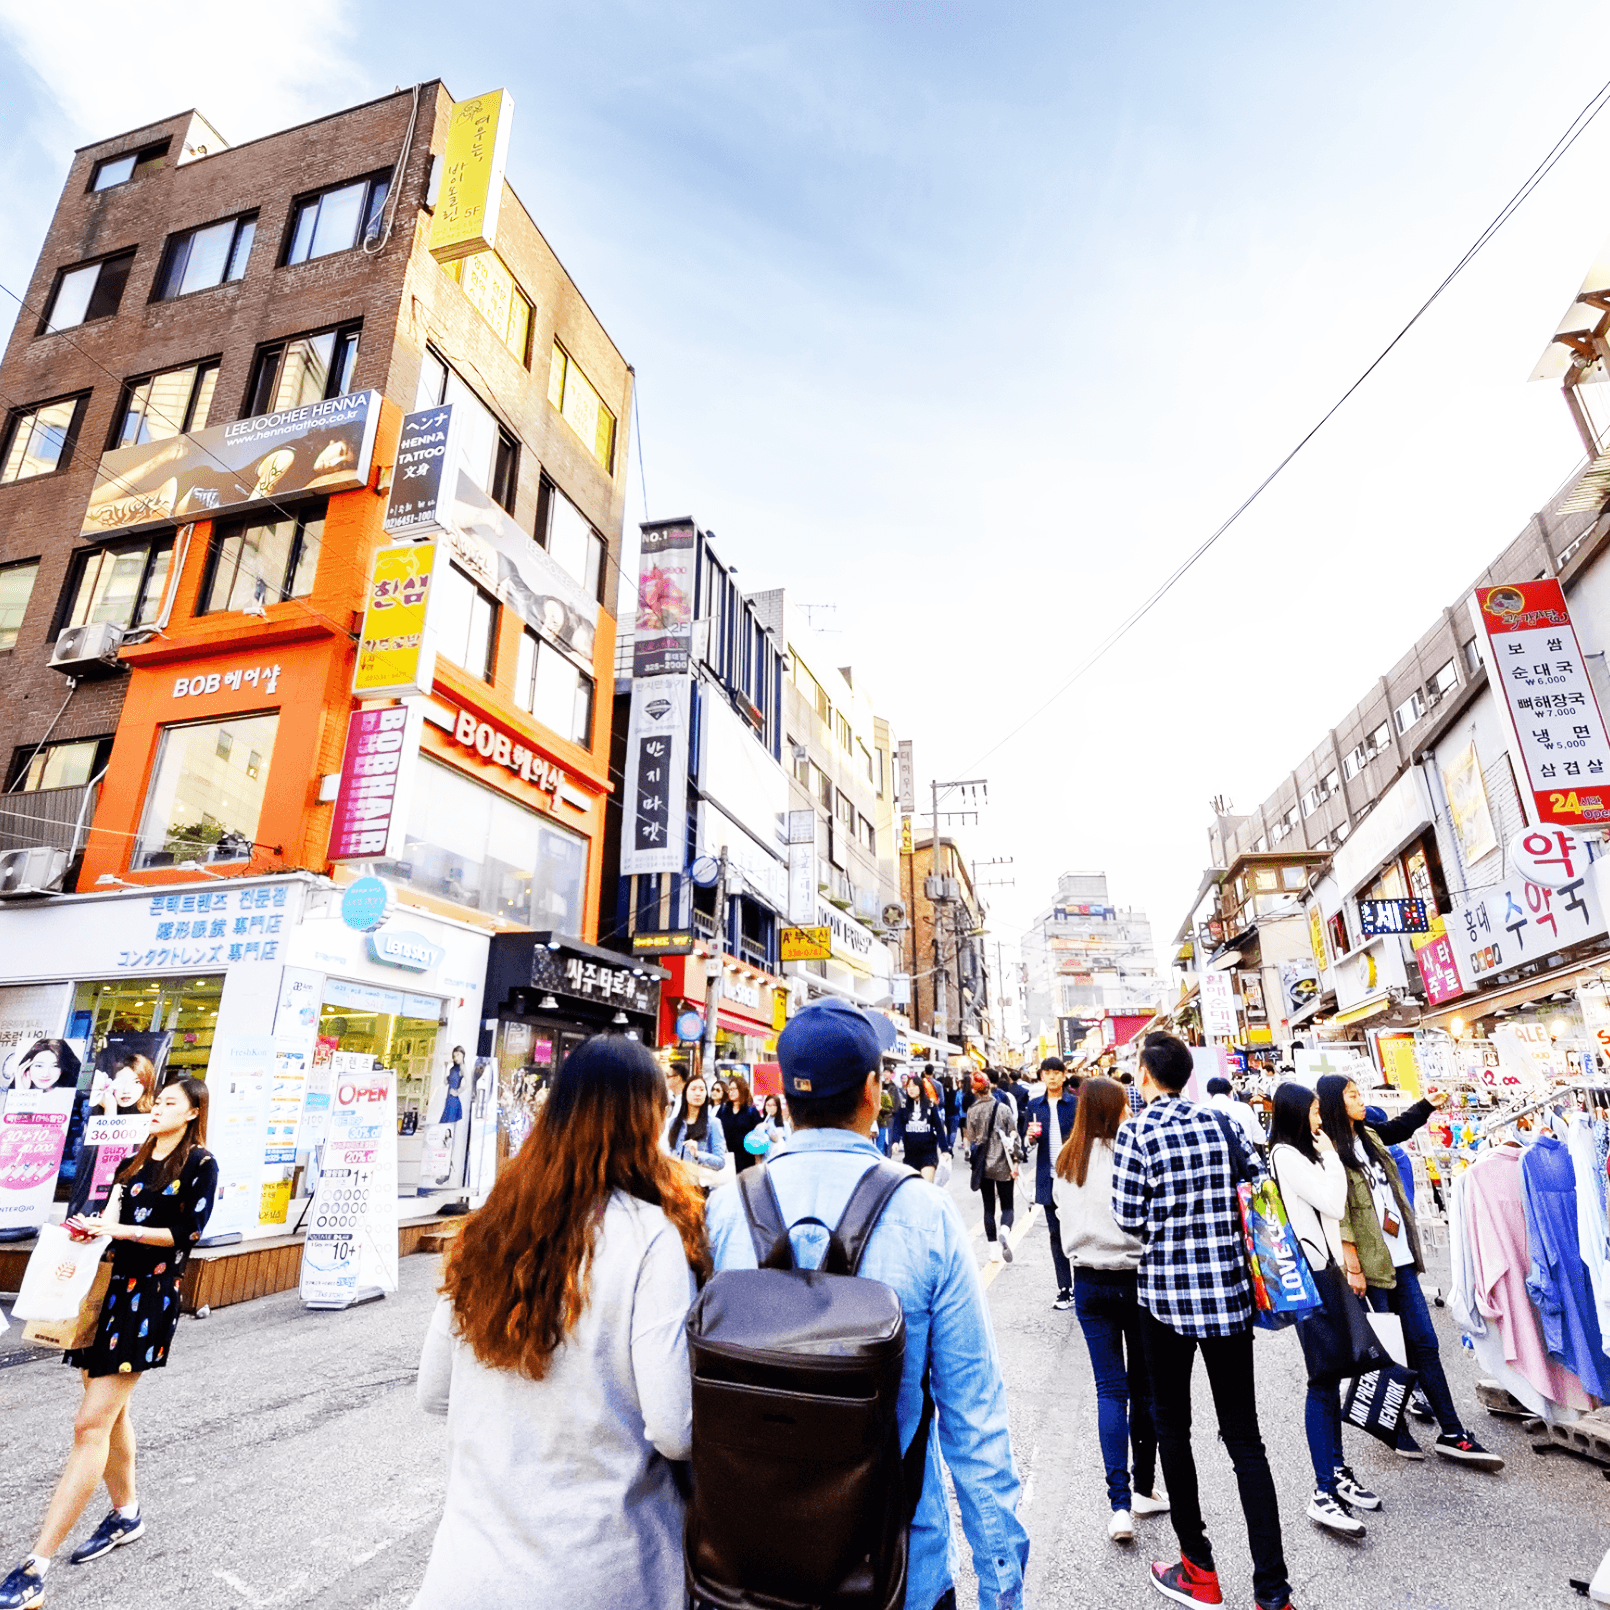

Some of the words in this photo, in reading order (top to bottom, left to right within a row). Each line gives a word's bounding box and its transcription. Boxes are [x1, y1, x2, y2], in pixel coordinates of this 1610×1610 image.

[464, 205, 481, 218] 5F
[225, 408, 309, 438] LEEJOOHEE
[312, 394, 367, 417] HENNA
[406, 412, 449, 430] ヘンナ
[227, 410, 358, 446] www.hennatattoo.co.kr
[400, 431, 445, 450] HENNA
[398, 446, 445, 464] TATTOO
[403, 462, 430, 480] 文身
[641, 530, 668, 543] NO.1
[671, 623, 688, 634] 2F
[1517, 692, 1586, 711] 뼈해장국
[1549, 791, 1583, 816] 24
[1582, 809, 1610, 820] Ope
[1522, 830, 1578, 878] 약
[149, 892, 228, 916] 콘택트렌즈
[239, 886, 289, 910] 전문점
[1464, 901, 1492, 943] 홍대
[1515, 1026, 1548, 1043] ALE
[230, 1048, 268, 1057] FreshKon
[338, 1083, 389, 1106] OPEN
[0, 1204, 35, 1213] NTEROJO
[1273, 1243, 1307, 1302] LOVE
[1354, 1369, 1381, 1405] PREMI
[1377, 1377, 1407, 1431] NEWYORK
